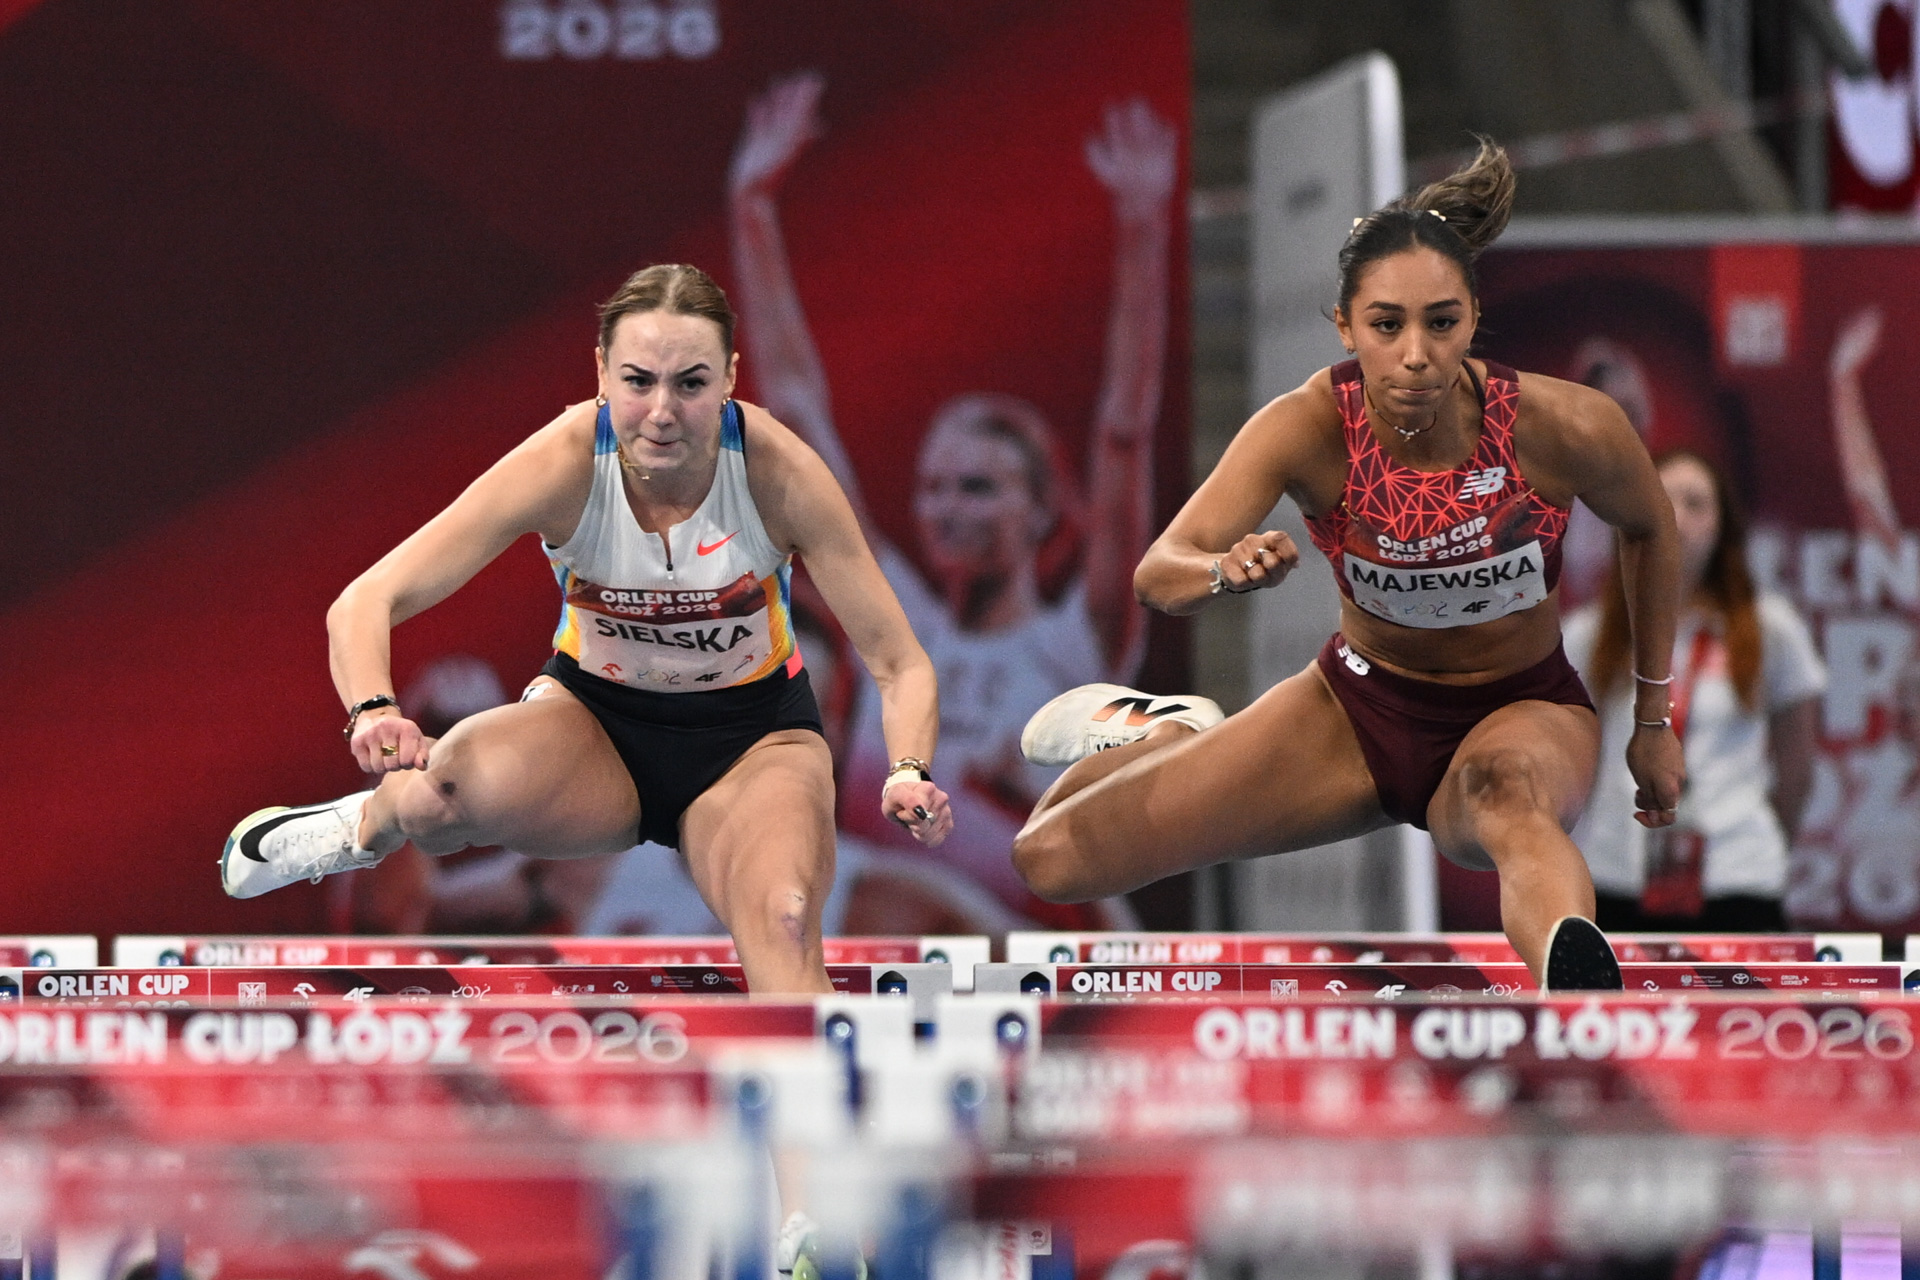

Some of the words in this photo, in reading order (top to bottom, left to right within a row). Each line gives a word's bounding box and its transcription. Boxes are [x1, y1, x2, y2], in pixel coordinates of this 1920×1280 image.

[502, 0, 720, 58] 2026
[1377, 531, 1447, 554] ORLEN
[1450, 515, 1488, 542] CUP
[1378, 547, 1430, 563] ŁÓDŹ
[1436, 534, 1493, 560] 2026
[1352, 555, 1536, 592] MAJEWSKA
[600, 590, 673, 605] ORLEN
[677, 590, 719, 603] CUP
[1461, 600, 1491, 614] 4F
[606, 603, 655, 616] ŁÓDŹ
[662, 602, 722, 615] 2026
[595, 618, 753, 653] SIELSKA
[694, 671, 723, 682] 4F
[196, 944, 277, 966] ORLEN
[283, 945, 328, 966] CUP
[1090, 944, 1171, 963] ORLEN
[1176, 944, 1223, 963] CUP
[38, 975, 129, 997] ORLEN
[138, 975, 189, 995] CUP
[1072, 971, 1162, 993] ORLEN
[1171, 971, 1222, 991] CUP
[1374, 985, 1406, 1000] 4F
[343, 987, 375, 1003] 4F
[183, 1012, 299, 1064] CUP
[306, 1000, 472, 1064] ŁÓDŹ
[490, 1011, 688, 1064] 2026
[1195, 1008, 1396, 1060] ORLEN
[1411, 1008, 1527, 1060] CUP
[1535, 998, 1700, 1060] ŁÓDŹ
[1718, 1008, 1914, 1061] 2026
